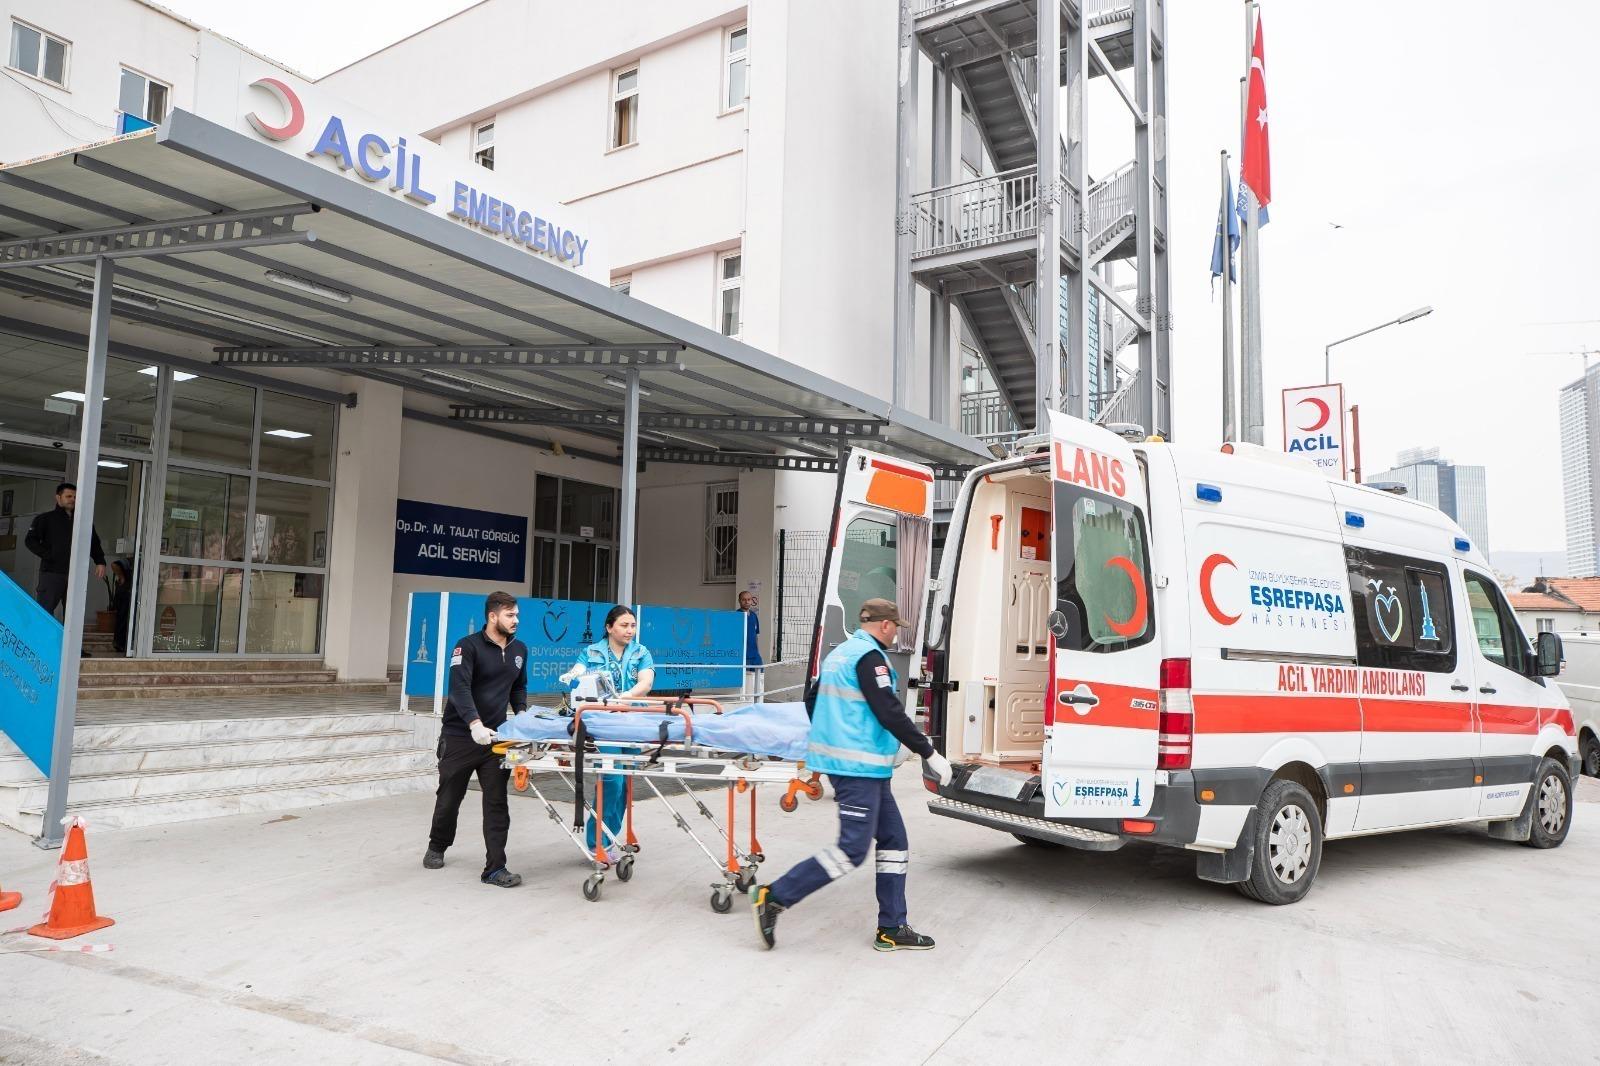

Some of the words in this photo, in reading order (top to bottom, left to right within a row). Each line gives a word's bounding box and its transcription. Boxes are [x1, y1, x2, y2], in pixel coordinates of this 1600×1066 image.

[312, 115, 436, 203] ACİL
[453, 180, 588, 266] EMERGENCY
[1289, 433, 1339, 452] ACİL
[1055, 442, 1126, 497] LANS
[433, 524, 446, 535] M.
[450, 526, 479, 539] TALAT
[417, 542, 448, 559] ACİL
[452, 547, 500, 564] SERVİSİ
[1250, 585, 1345, 618] EŞREFPAŞA
[1311, 666, 1358, 694] YARDIM
[1075, 786, 1128, 800] EŞREFPAŞA
